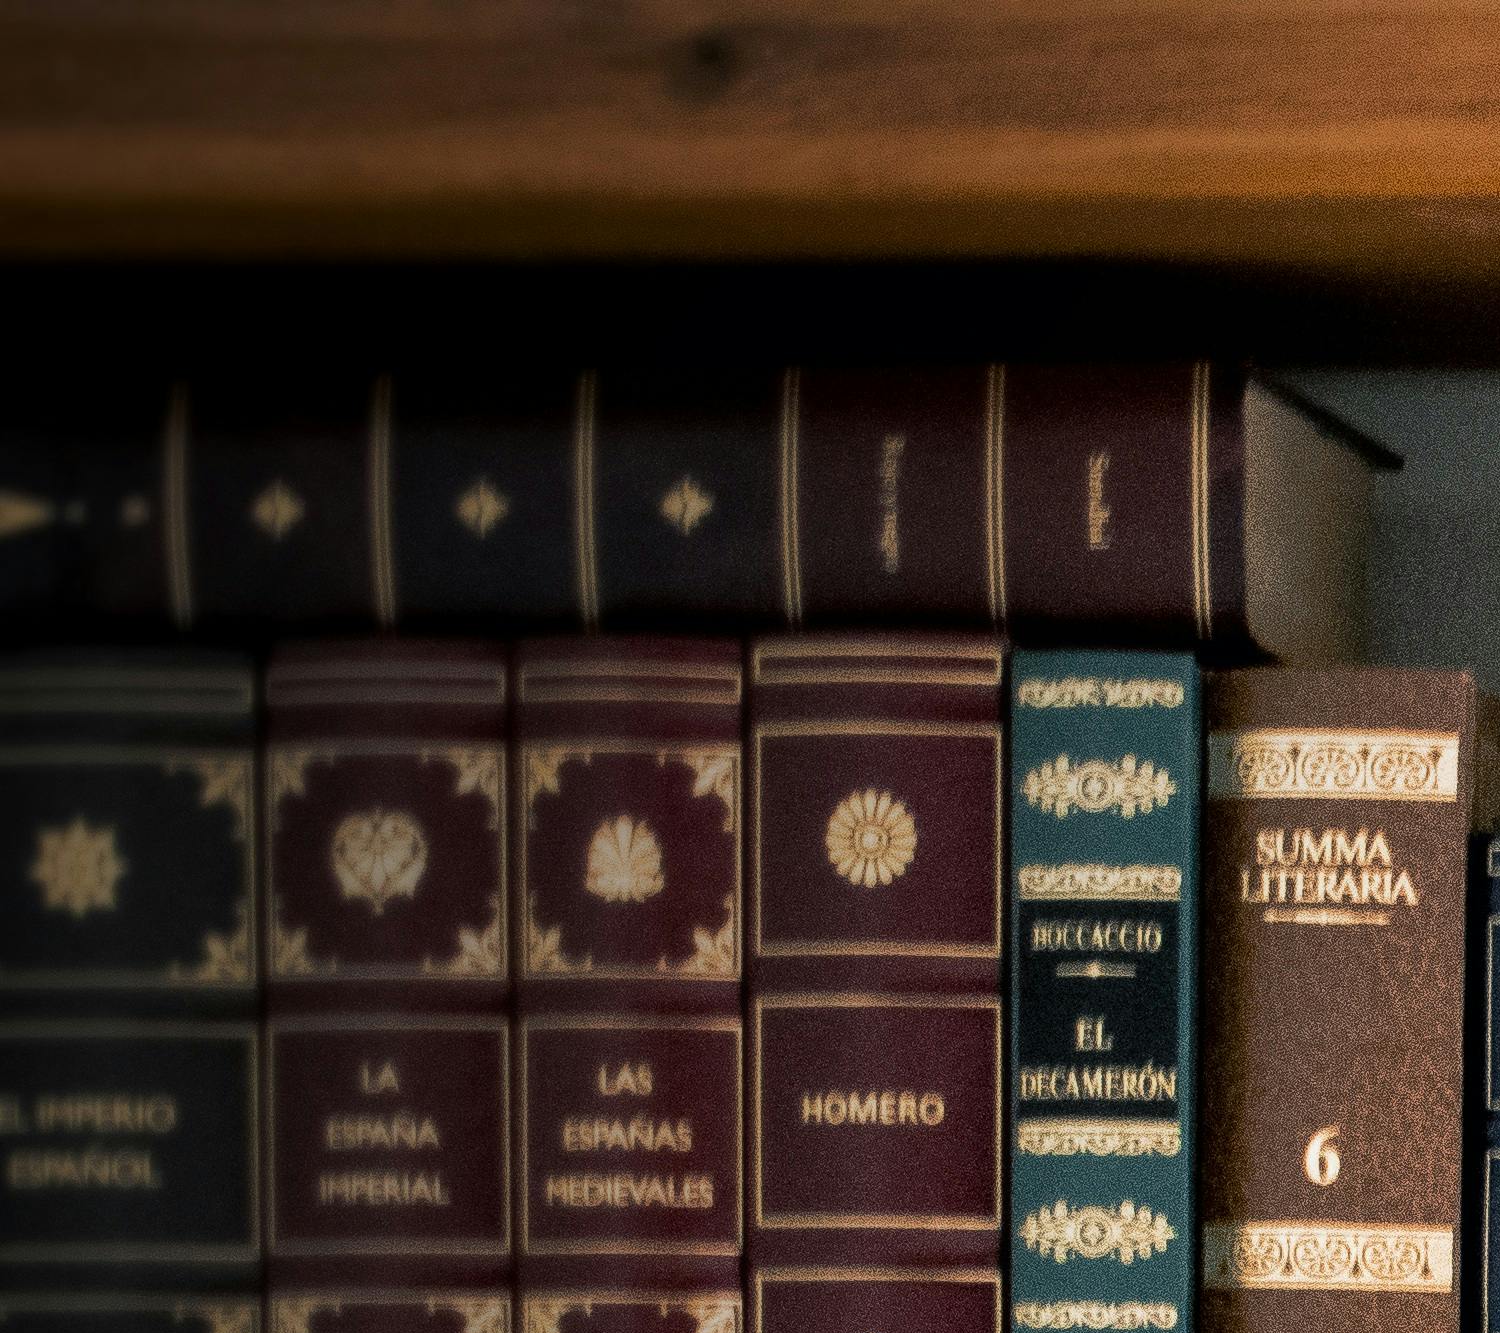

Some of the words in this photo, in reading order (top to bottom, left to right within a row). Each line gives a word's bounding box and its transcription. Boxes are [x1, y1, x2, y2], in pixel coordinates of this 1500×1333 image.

[1258, 830, 1391, 865] SUMMA
[1244, 867, 1417, 905] LITERARIA
[1032, 921, 1163, 952] BOCCACCIO
[1076, 1017, 1112, 1051] EL
[1020, 1063, 1178, 1100] DECAMERÓN
[802, 1092, 945, 1125] HOMERO
[1304, 1128, 1340, 1185] 6
